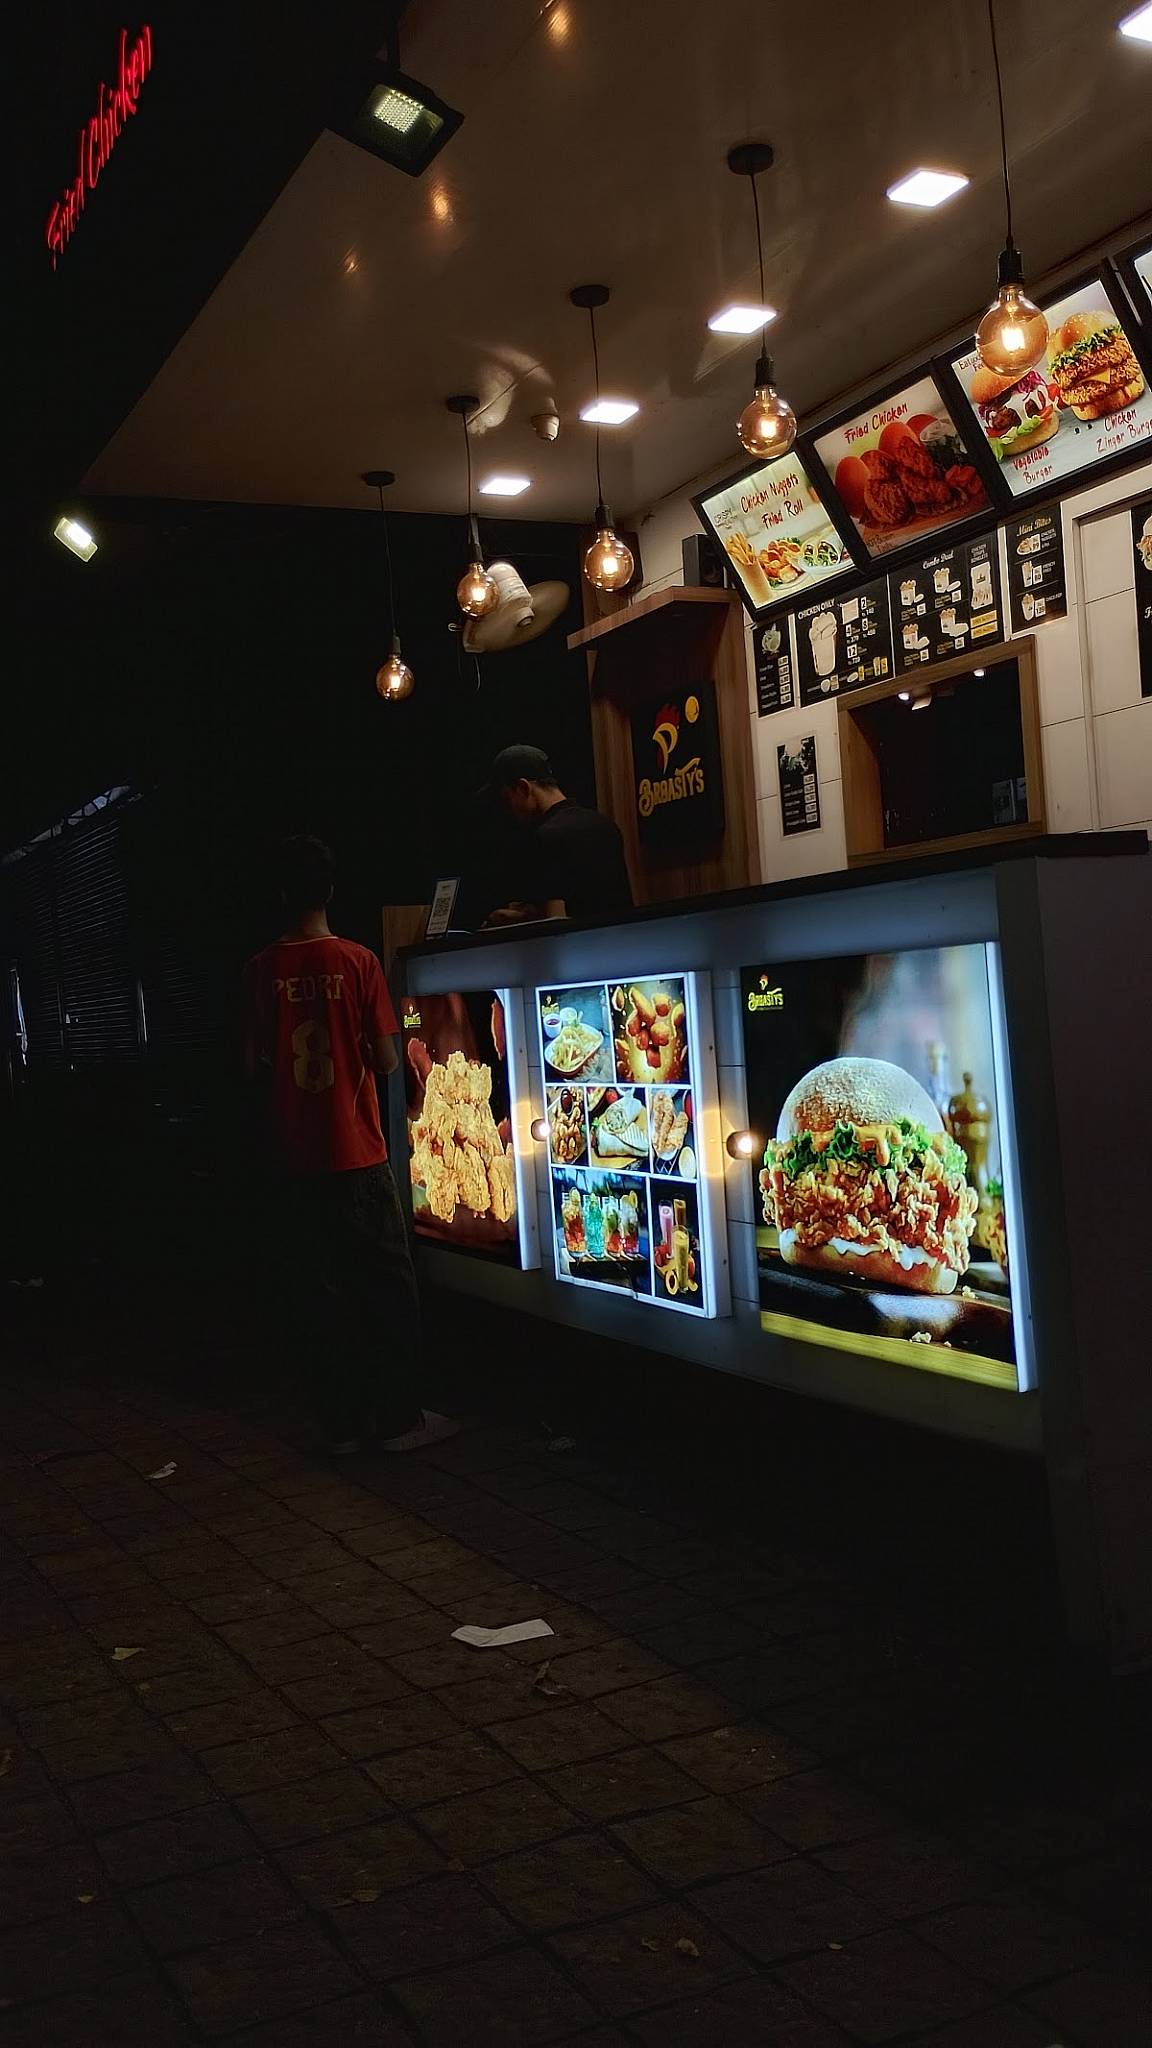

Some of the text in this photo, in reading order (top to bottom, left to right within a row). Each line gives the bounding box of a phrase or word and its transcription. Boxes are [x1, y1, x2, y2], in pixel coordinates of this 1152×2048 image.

[44, 23, 153, 272] Fried Chicken
[844, 402, 908, 444] Fried Chicken
[1104, 408, 1137, 432] Chicken
[1096, 431, 1125, 453] Zinger
[1012, 446, 1050, 470] Vegetable
[1023, 464, 1053, 484] Burger
[741, 472, 799, 513] Chicken Nuggets
[762, 498, 804, 529] Fried Roll
[798, 598, 835, 620] CHICKEN ONLY
[272, 974, 345, 1003] PEDRI
[291, 1019, 336, 1094] 8
